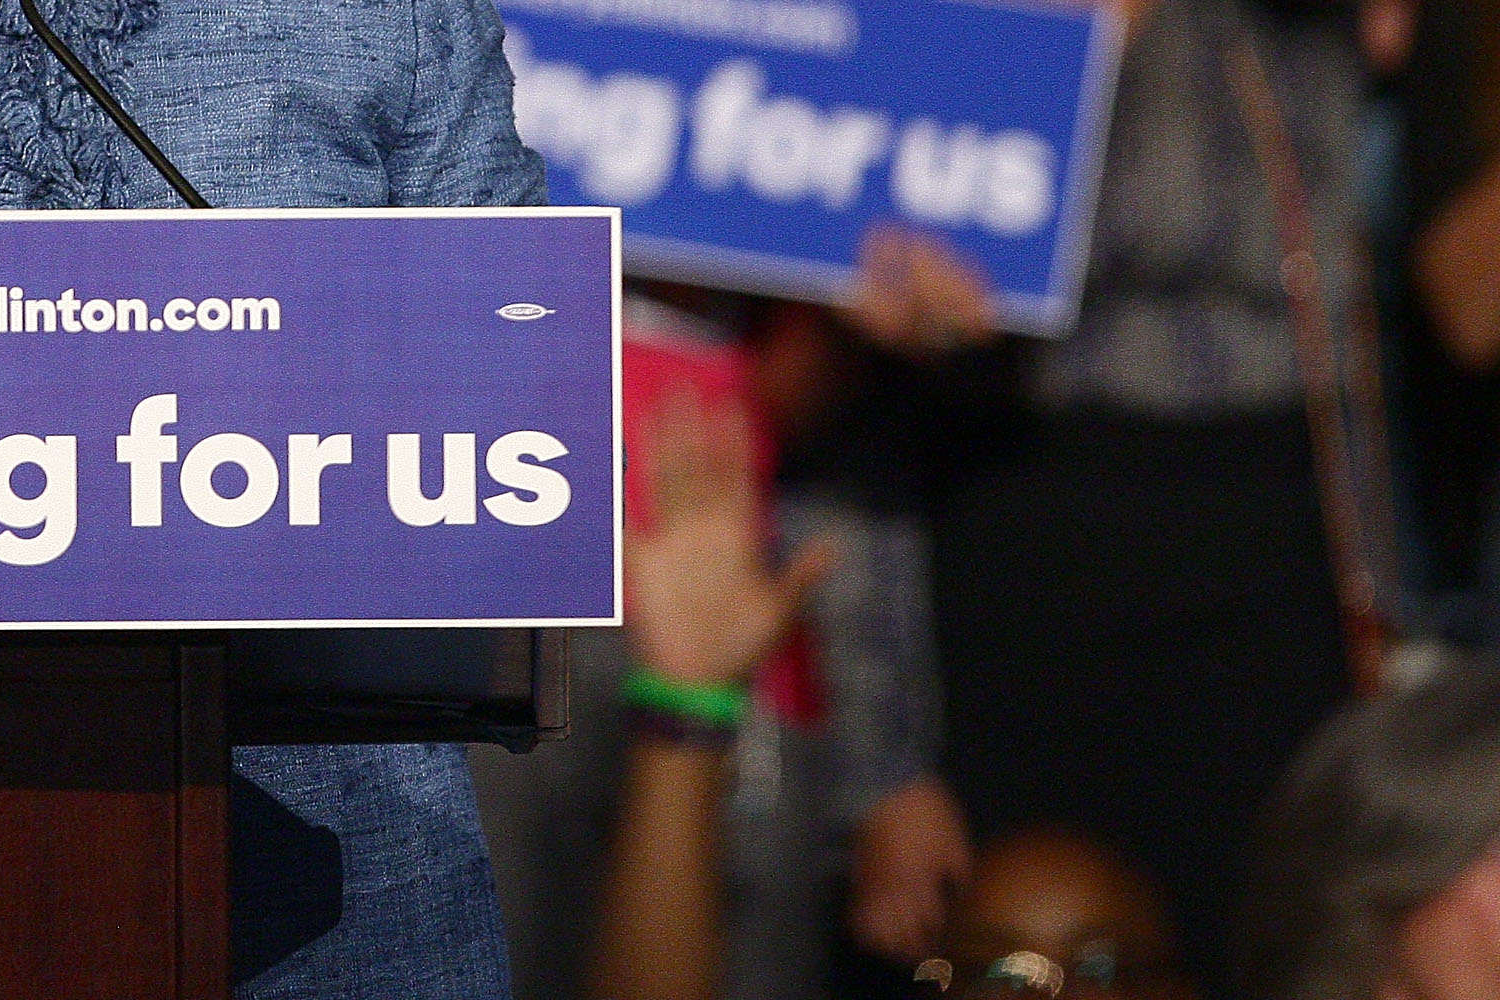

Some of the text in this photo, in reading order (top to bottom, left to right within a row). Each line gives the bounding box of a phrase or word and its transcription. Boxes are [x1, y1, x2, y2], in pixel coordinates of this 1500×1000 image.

[690, 58, 888, 209] for
[891, 118, 1055, 236] us
[116, 392, 353, 529] for
[385, 429, 572, 528] us
